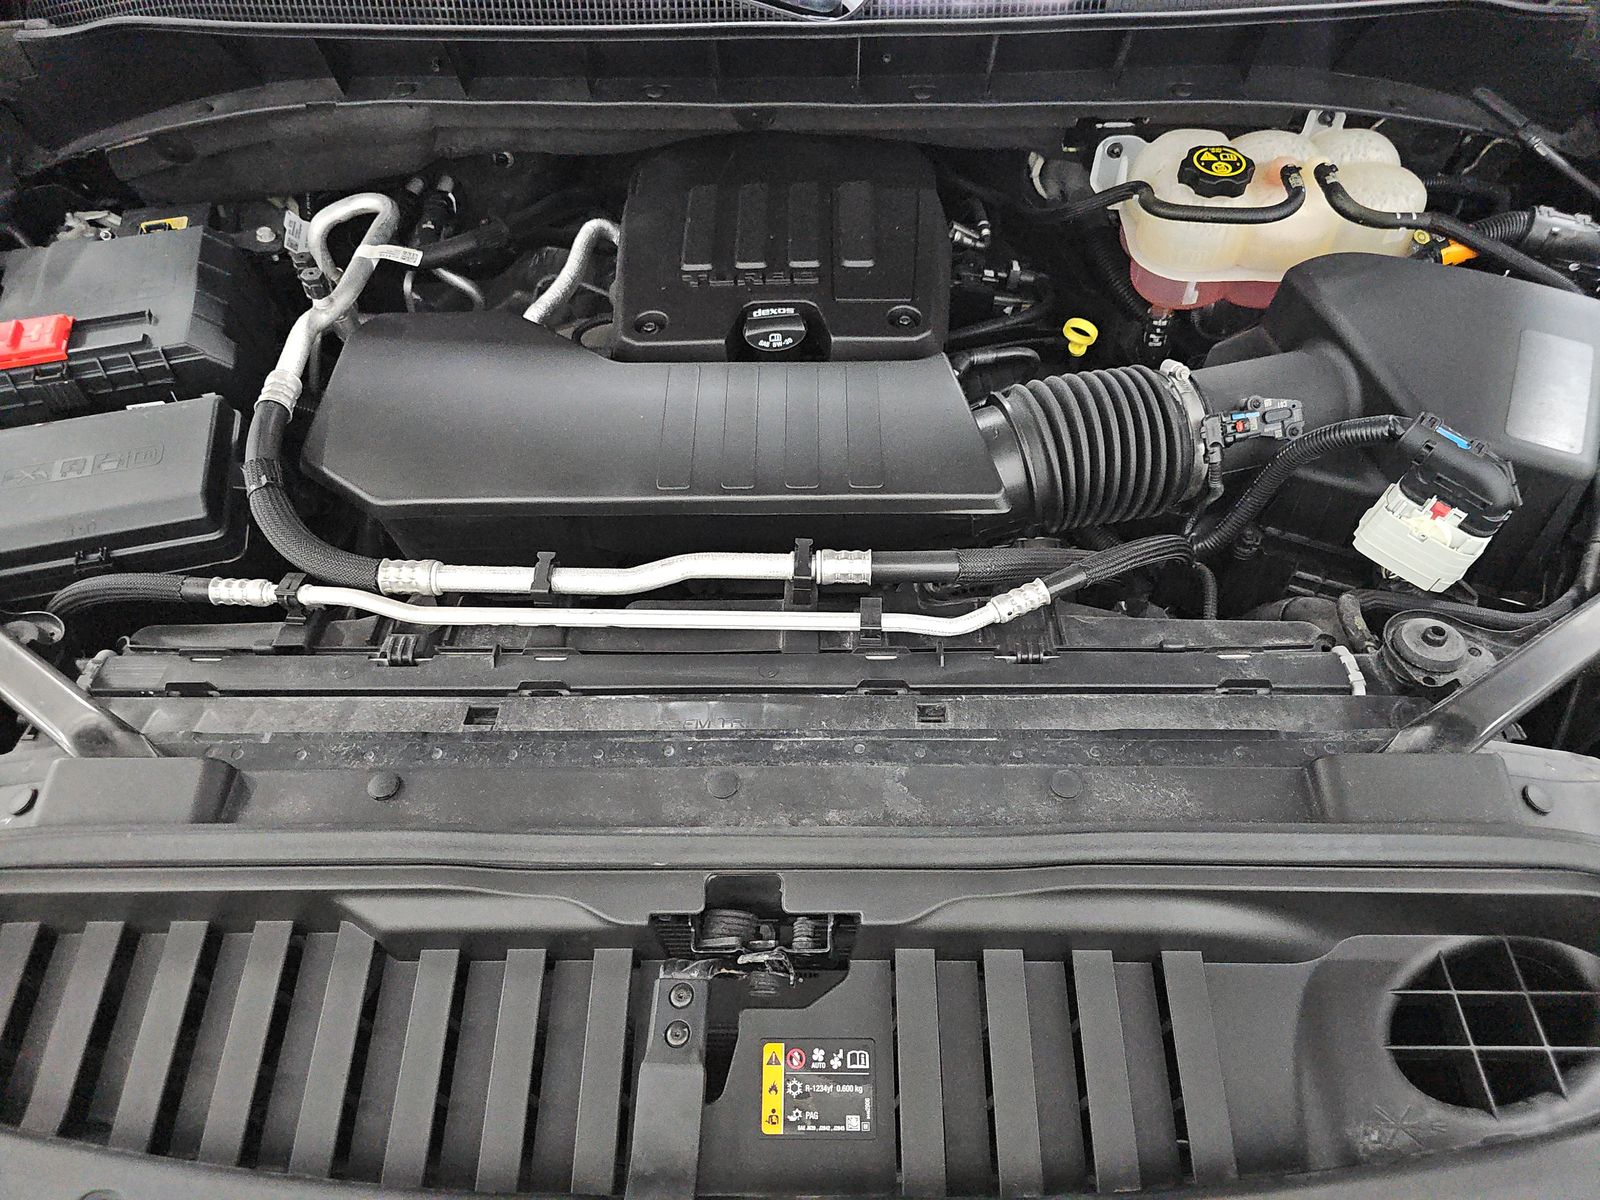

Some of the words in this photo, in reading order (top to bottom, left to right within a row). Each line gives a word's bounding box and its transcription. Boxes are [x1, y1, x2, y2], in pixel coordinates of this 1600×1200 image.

[752, 307, 796, 318] dexos
[805, 1085, 834, 1094] R-1234yf
[836, 1085, 854, 1093] 0.600
[854, 1085, 863, 1094] kg
[805, 1111, 819, 1120] PAG
